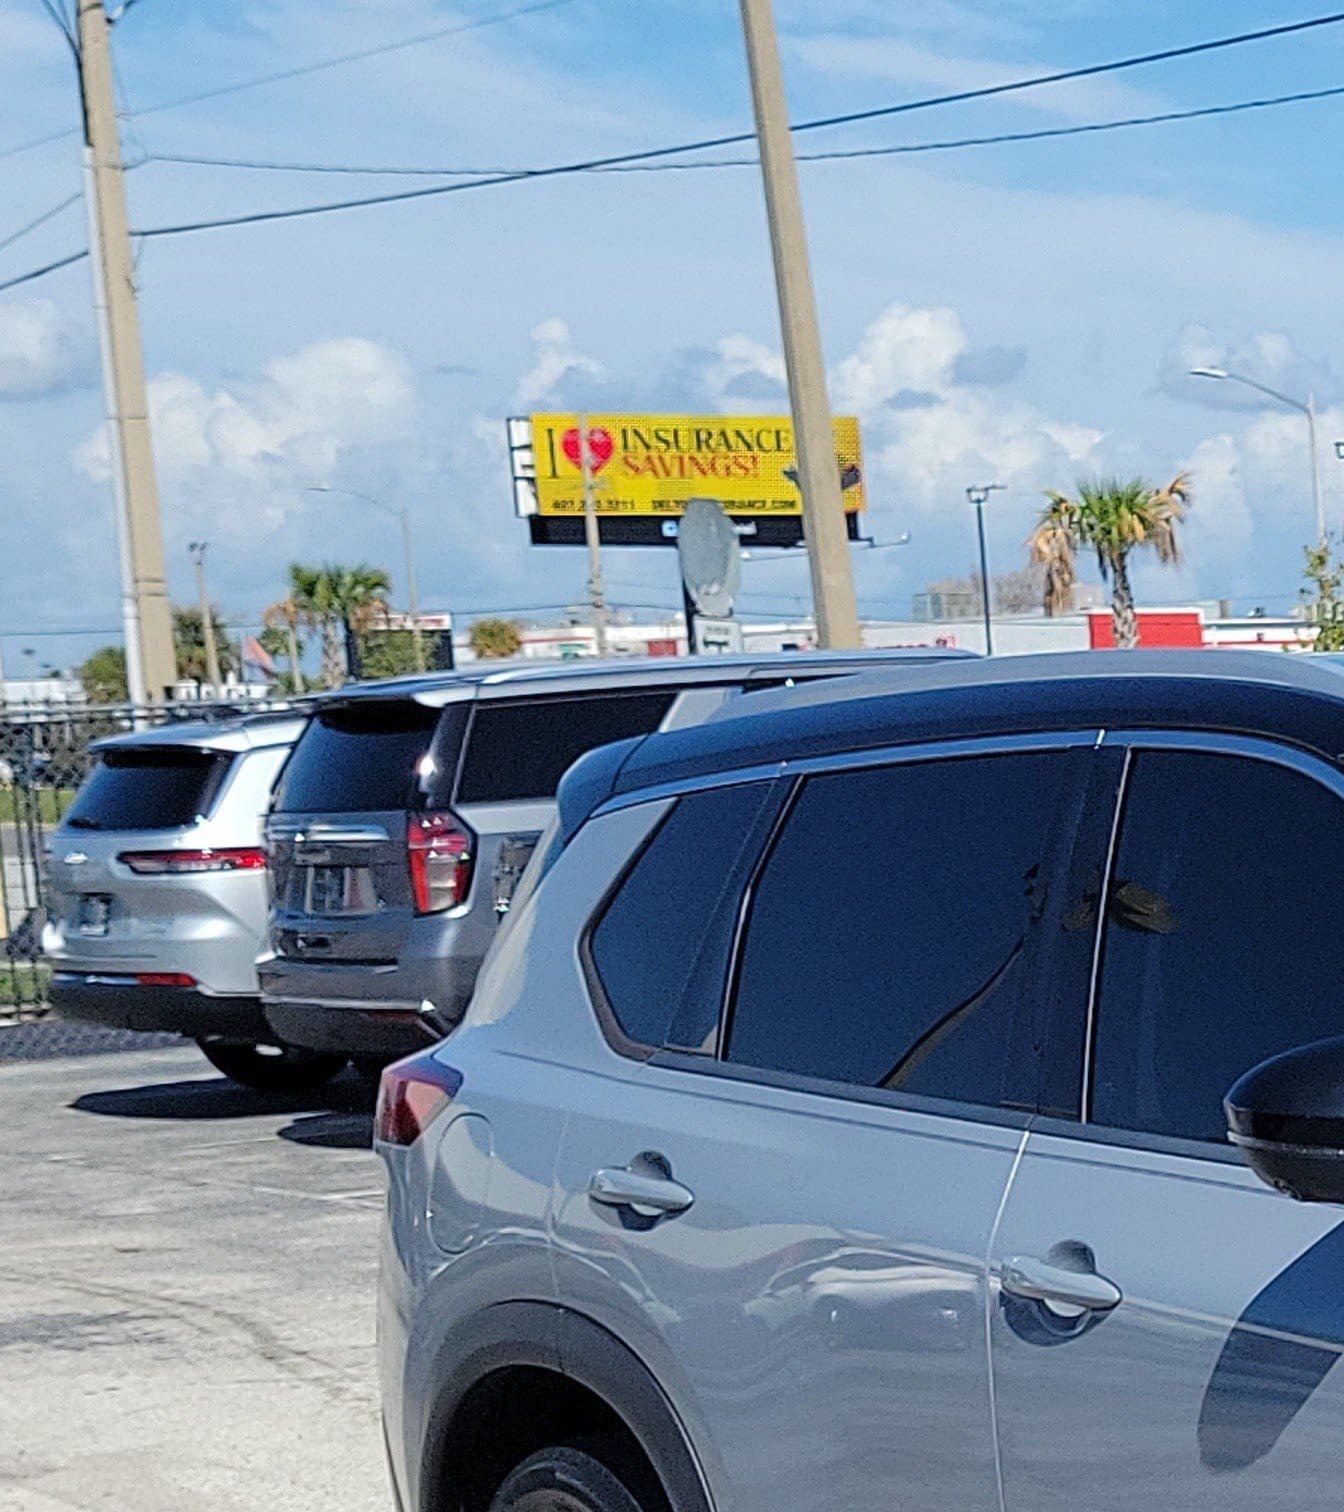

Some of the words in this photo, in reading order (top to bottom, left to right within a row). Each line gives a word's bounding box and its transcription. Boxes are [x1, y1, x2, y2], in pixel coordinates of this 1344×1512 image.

[547, 427, 559, 479] I
[621, 428, 791, 453] INSURANCE
[622, 454, 760, 480] SAVINGS!
